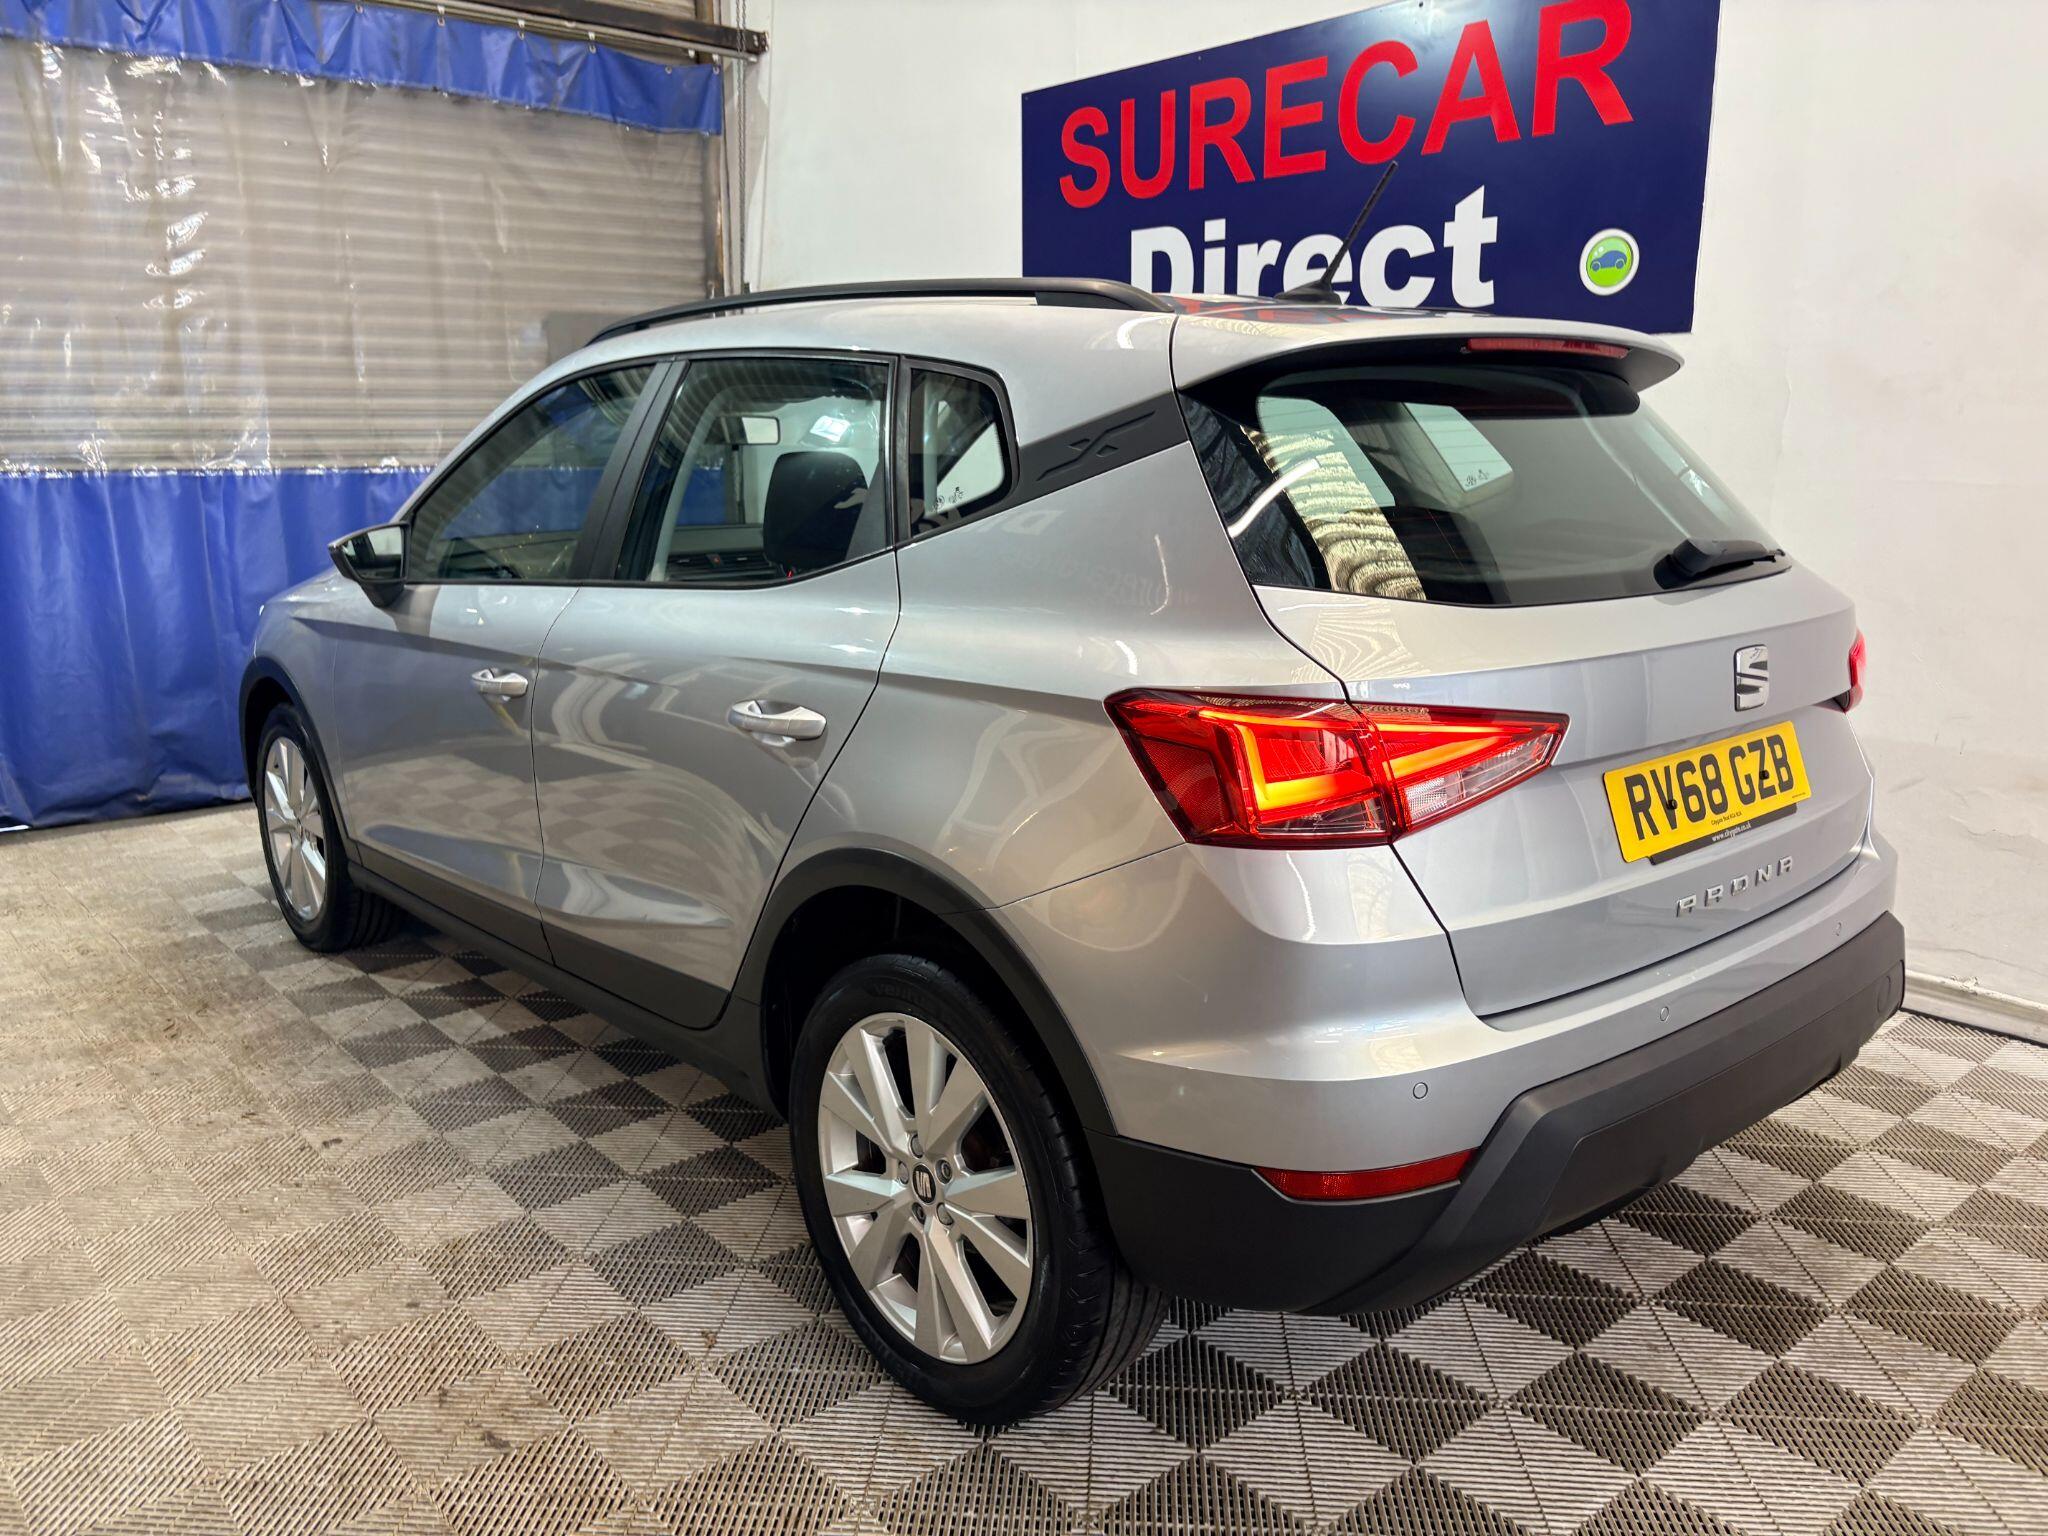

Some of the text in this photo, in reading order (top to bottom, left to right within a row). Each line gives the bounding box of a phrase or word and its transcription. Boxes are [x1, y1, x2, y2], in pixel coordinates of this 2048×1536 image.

[1059, 0, 1634, 208] SURECAR
[1130, 184, 1498, 308] Direct
[1624, 734, 1795, 841] RV68 GZB
[1676, 855, 1793, 917] ARONA
